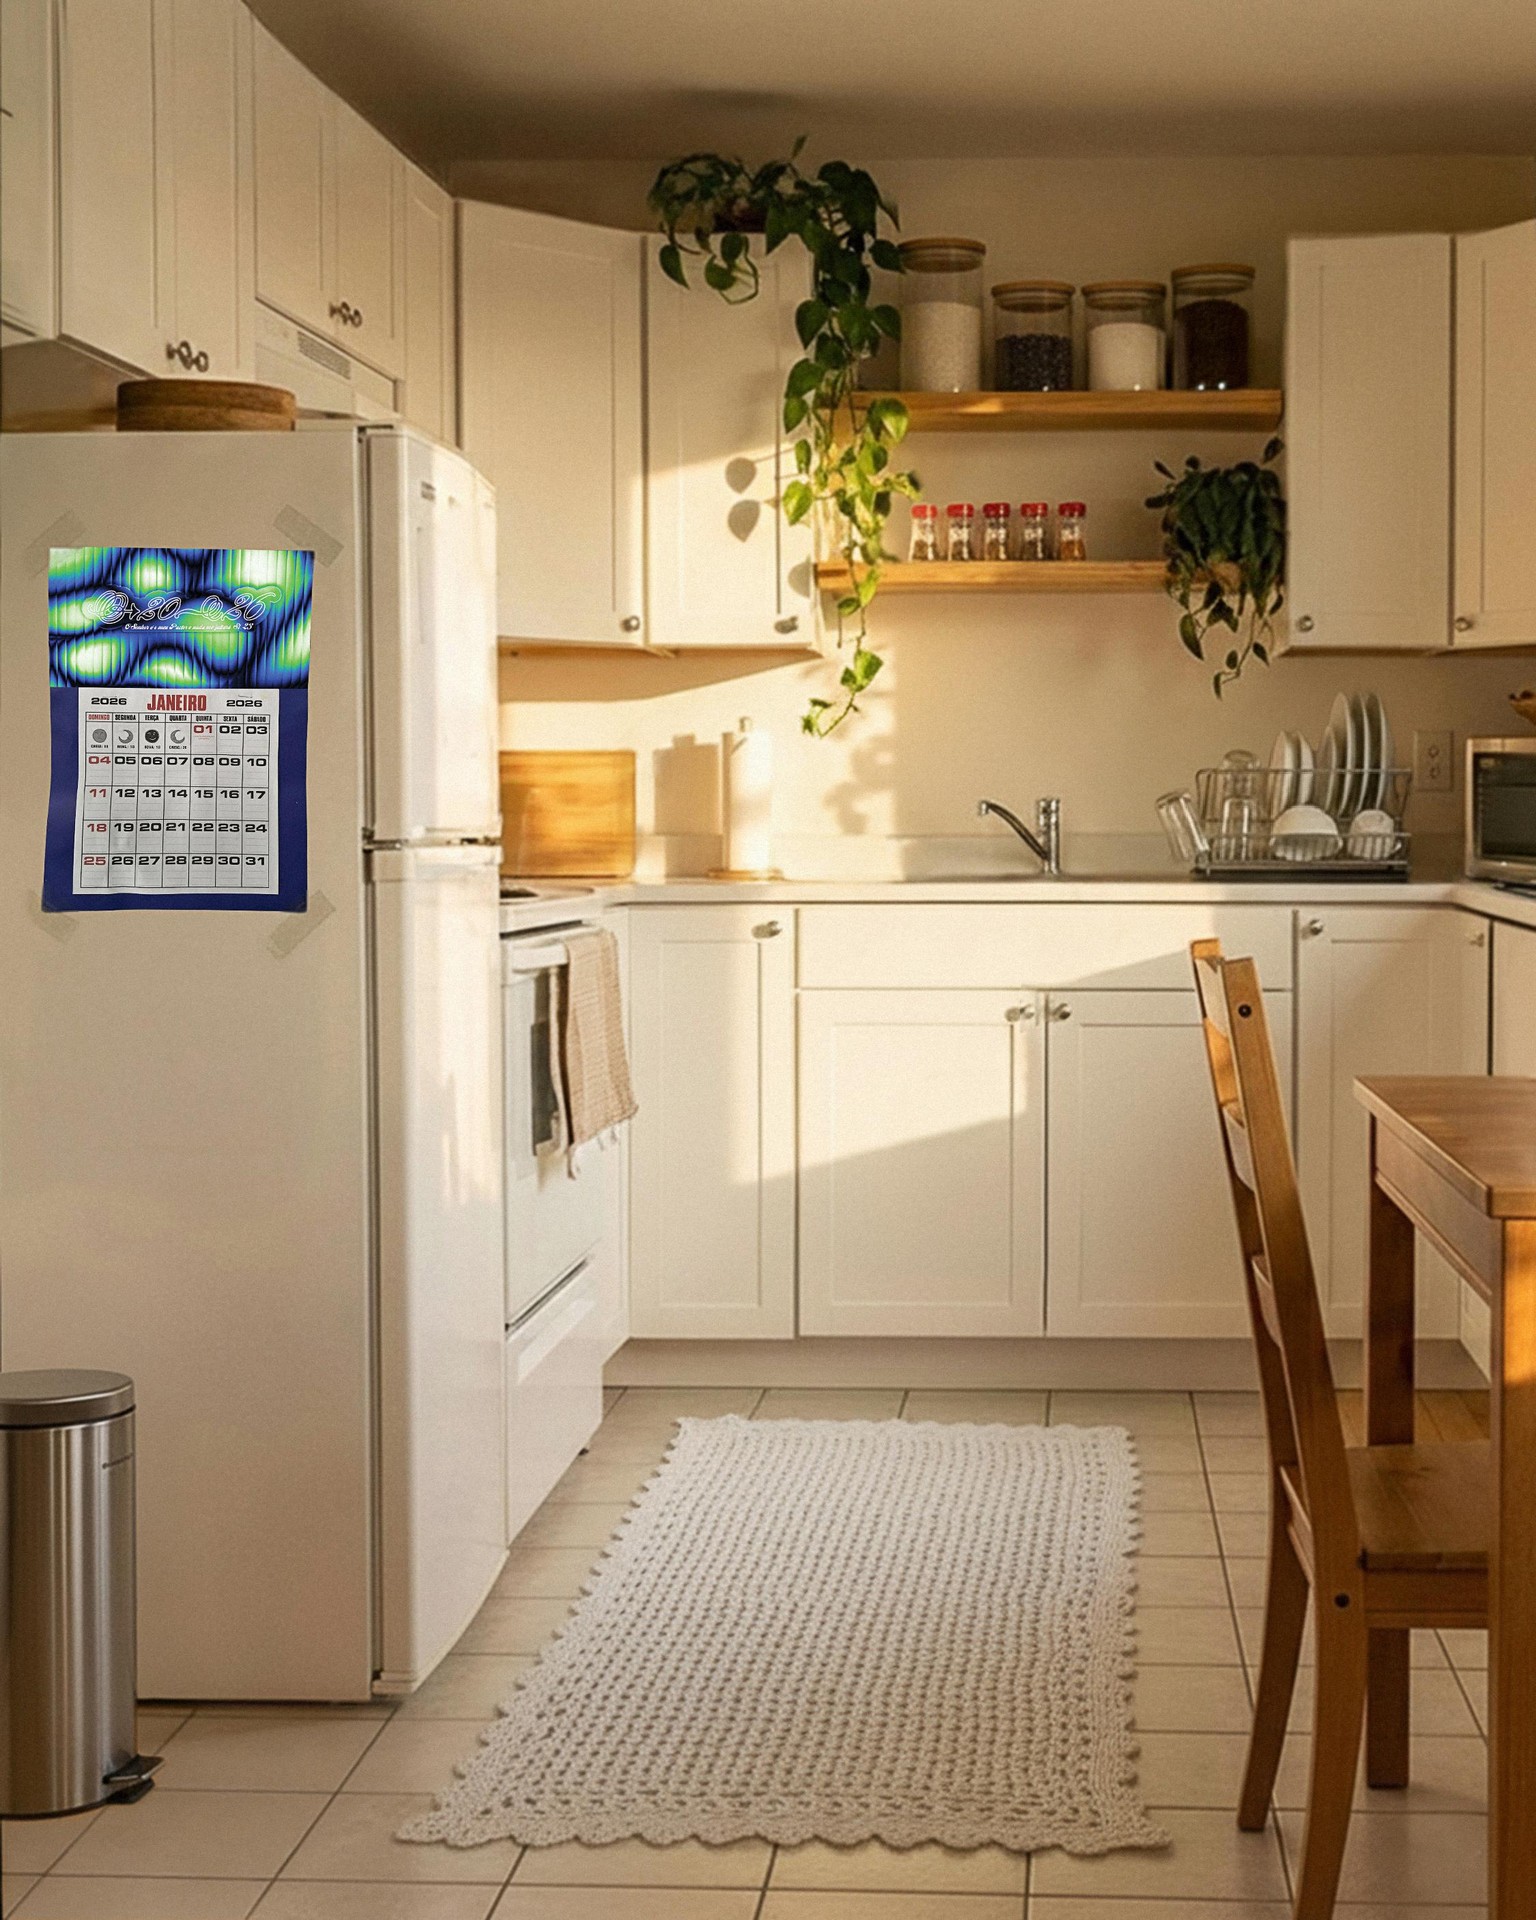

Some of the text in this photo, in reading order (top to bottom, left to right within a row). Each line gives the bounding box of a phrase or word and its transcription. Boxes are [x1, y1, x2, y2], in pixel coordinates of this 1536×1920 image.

[147, 694, 206, 711] JANEIRO
[194, 725, 267, 734] 01 02 03
[89, 756, 111, 764] 04
[115, 756, 136, 764] 05
[141, 757, 162, 765] 06
[167, 757, 188, 765] 07
[219, 758, 240, 766] 09
[90, 789, 106, 797] 11
[115, 789, 135, 797] 12
[195, 790, 213, 798] 15
[220, 790, 239, 798] 16
[247, 791, 265, 799] 17
[87, 823, 267, 833] 18 19 20 21 22 23 24
[84, 856, 264, 865] 25 26 27 28 29 30 31
